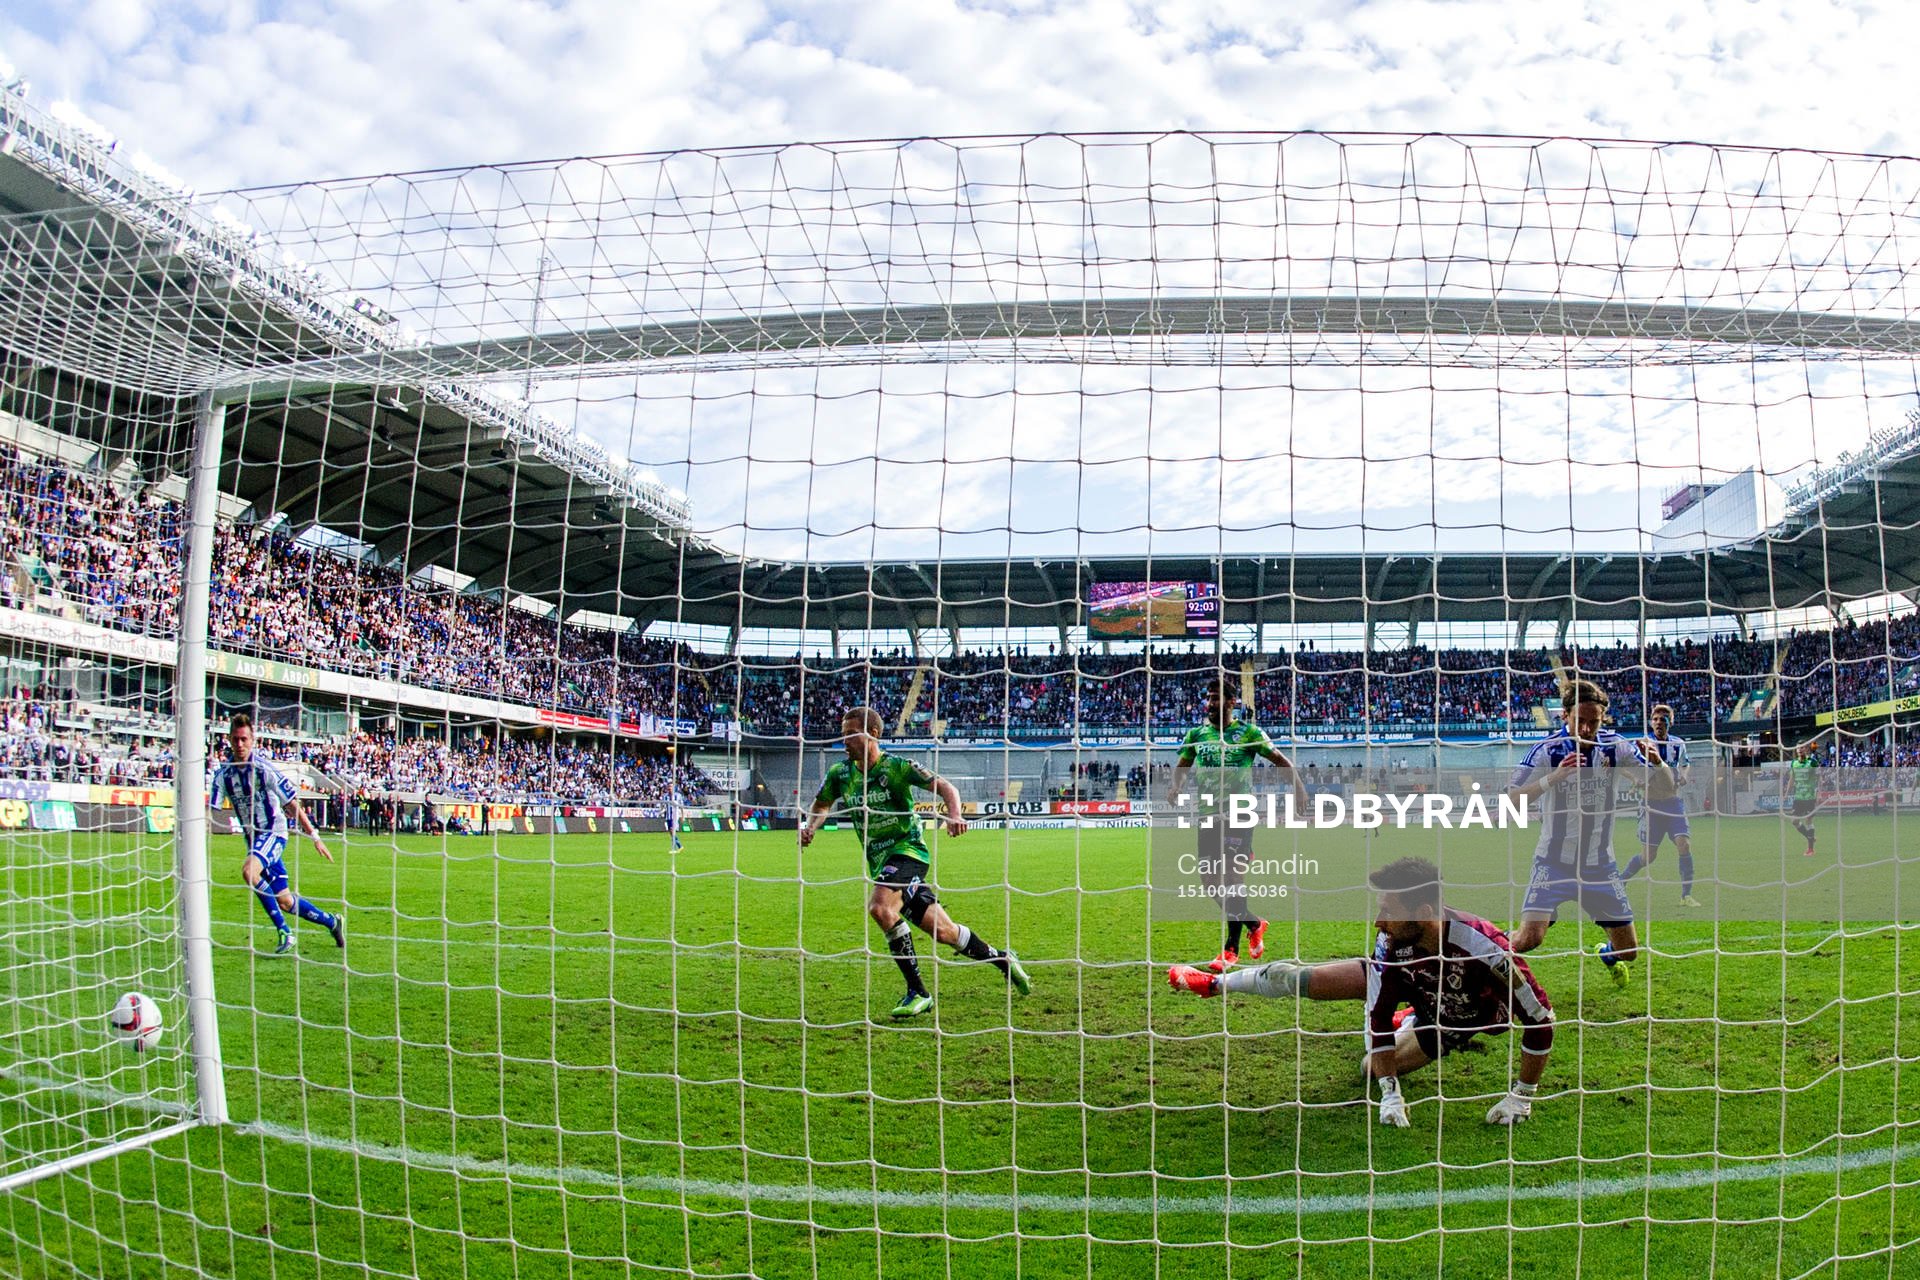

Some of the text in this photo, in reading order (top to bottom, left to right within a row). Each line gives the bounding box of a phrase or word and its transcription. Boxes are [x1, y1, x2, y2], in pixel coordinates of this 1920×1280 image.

[1188, 602, 1214, 611] 92:03
[913, 802, 967, 813] GoodCh
[984, 802, 1043, 815] GITAB
